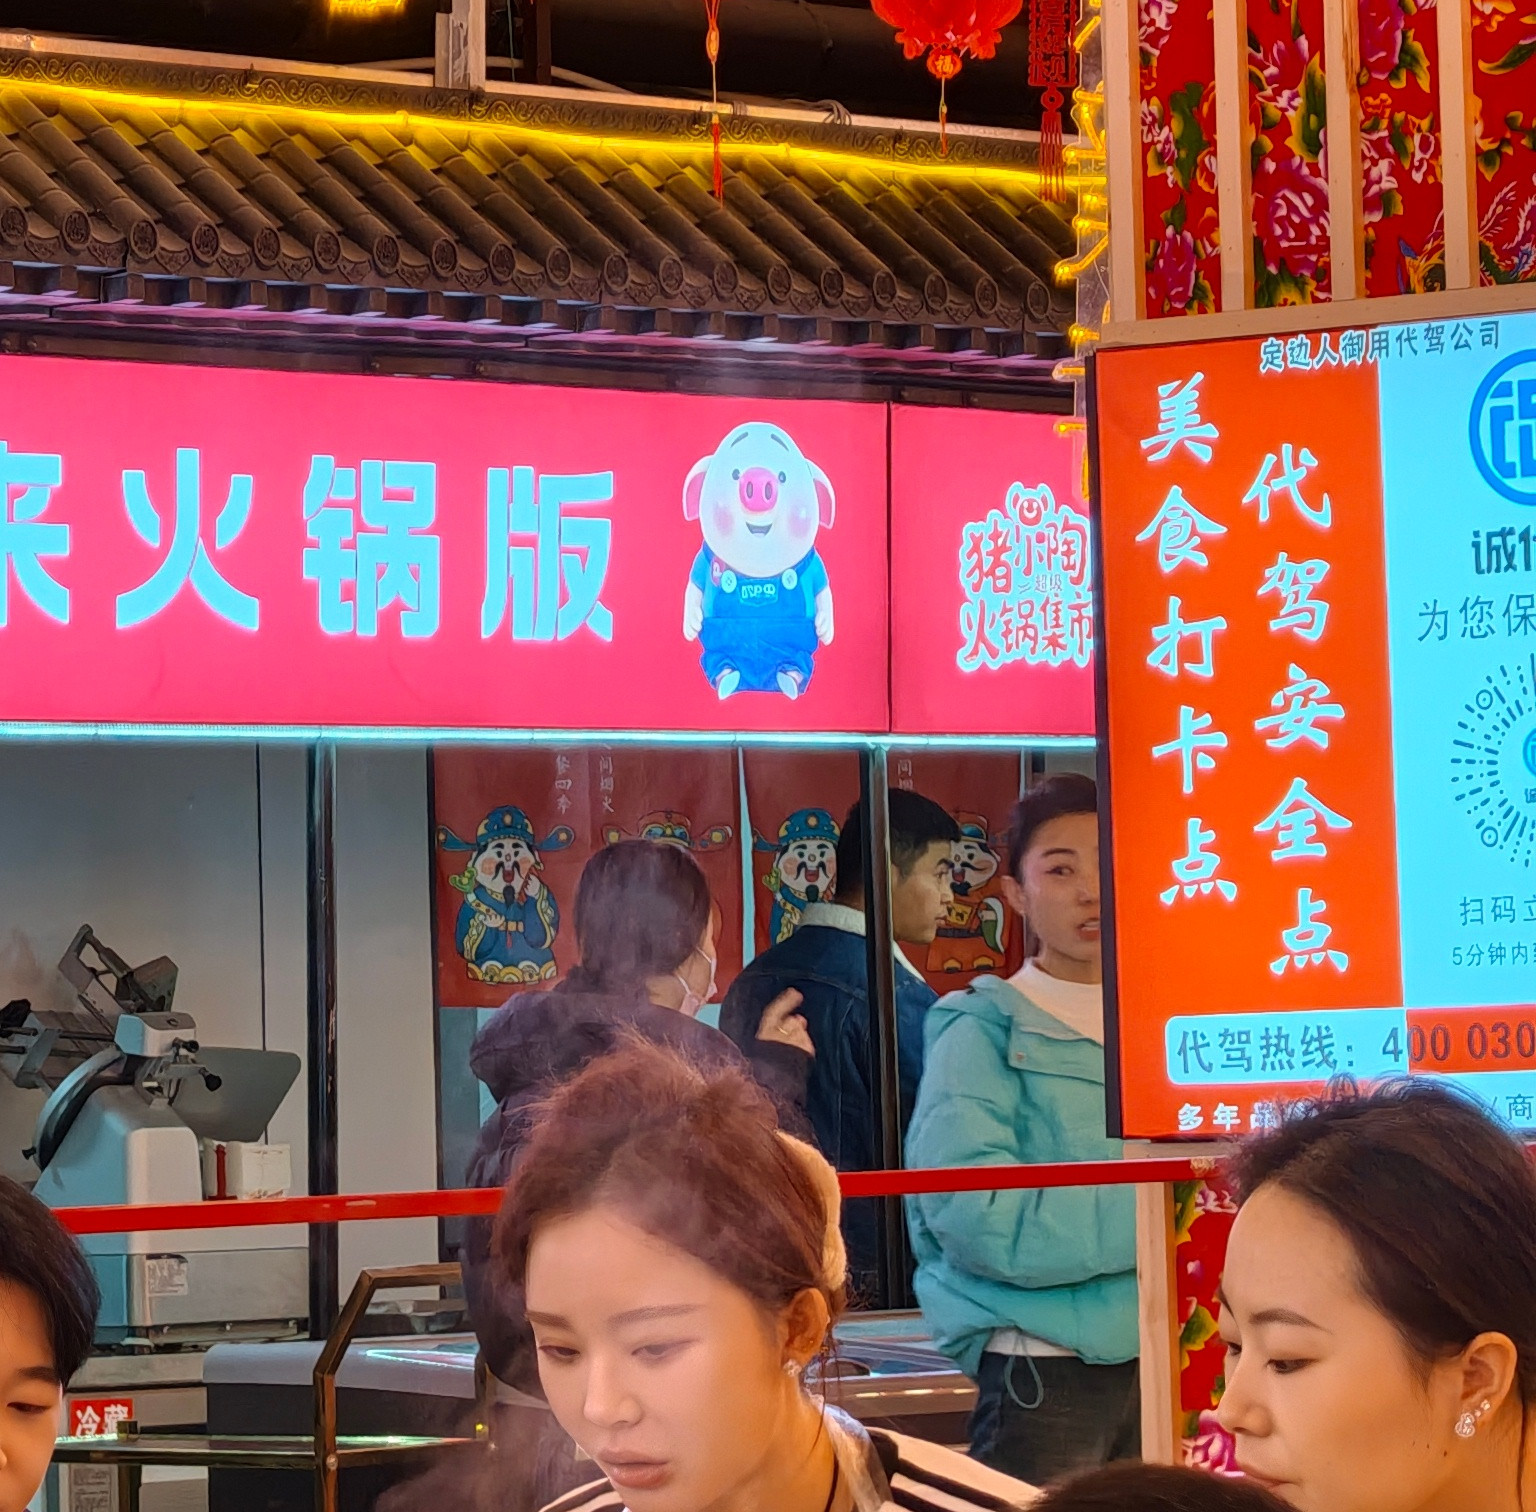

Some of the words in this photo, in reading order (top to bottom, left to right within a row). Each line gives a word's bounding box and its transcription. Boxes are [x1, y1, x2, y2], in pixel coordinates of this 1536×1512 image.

[1261, 320, 1500, 370] 定边人御用代驾公司
[964, 592, 1092, 663] 火锅集市
[1136, 372, 1238, 904] 美食打卡点
[1418, 592, 1536, 642] 为您保
[1242, 443, 1352, 976] 代驾安全点
[600, 742, 614, 814] 间烟火
[1452, 941, 1536, 967] 5分钟内
[1382, 1025, 1450, 1063] 400
[1468, 1020, 1536, 1061] 030
